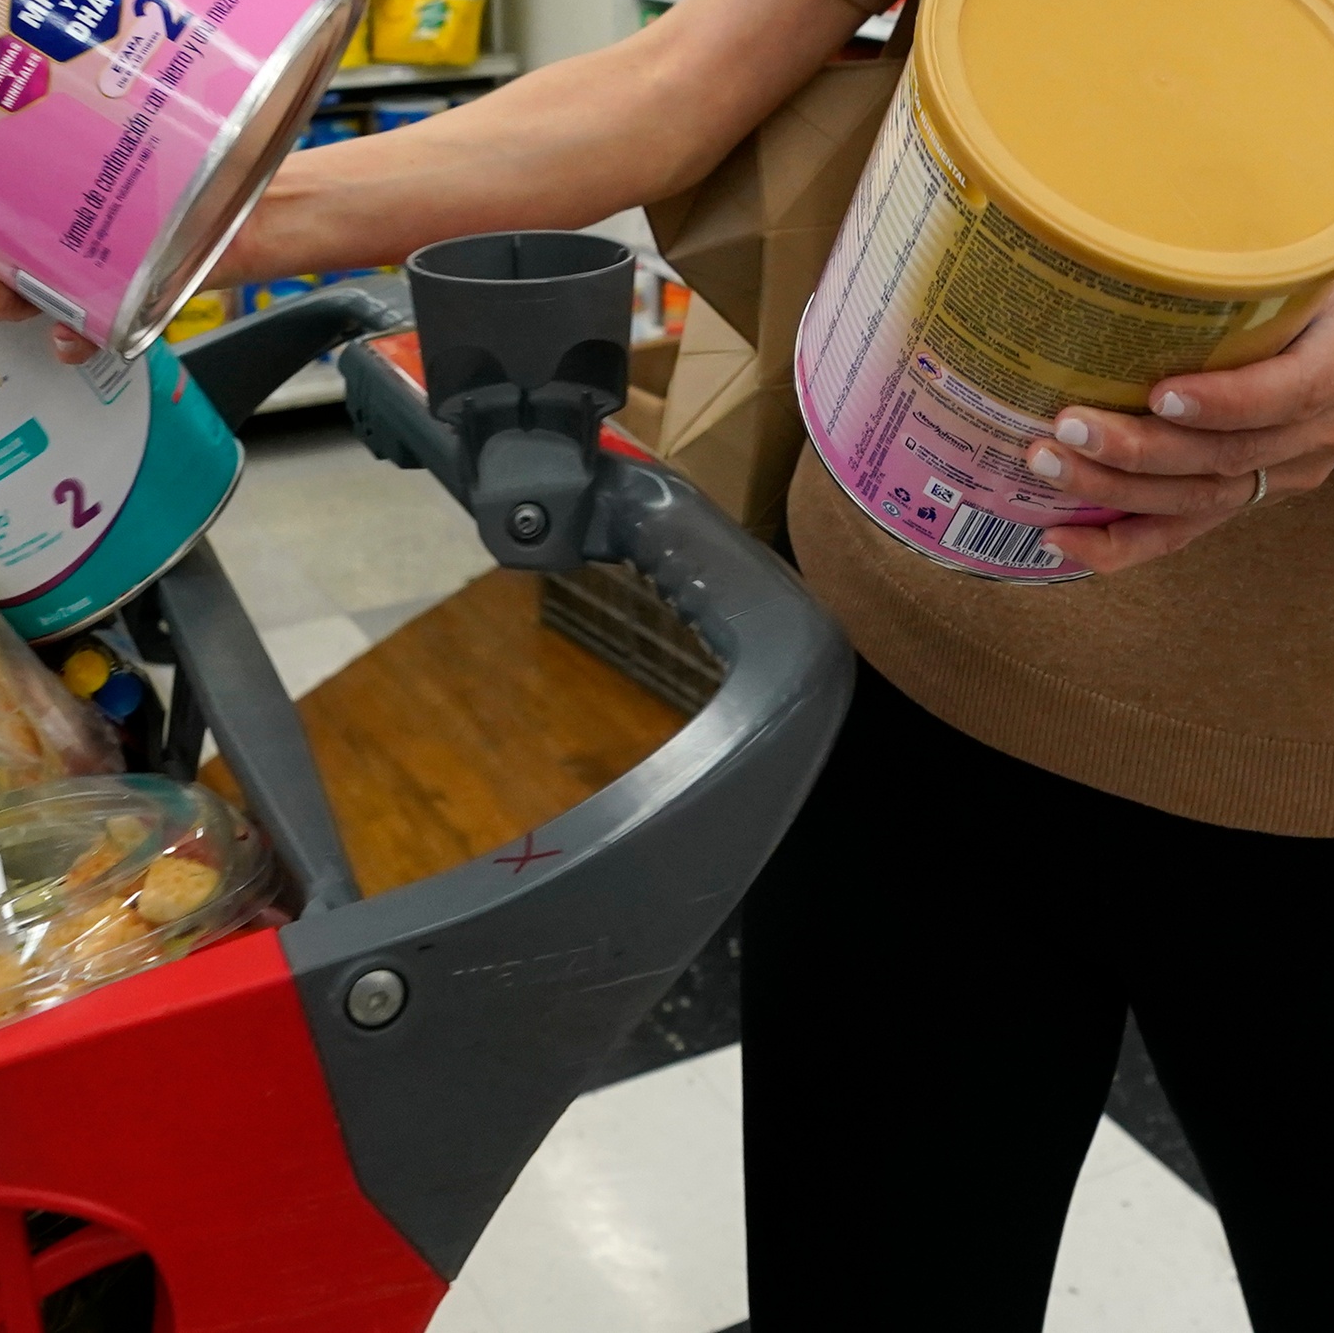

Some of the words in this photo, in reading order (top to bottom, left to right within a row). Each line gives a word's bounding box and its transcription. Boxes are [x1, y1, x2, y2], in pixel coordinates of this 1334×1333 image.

[1, 53, 43, 109] MINERALES
[80, 188, 106, 210] de
[95, 110, 152, 192] continuación
[143, 87, 169, 115] con
[920, 111, 966, 189] NUTRIMENTAL
[53, 477, 102, 529] 2
